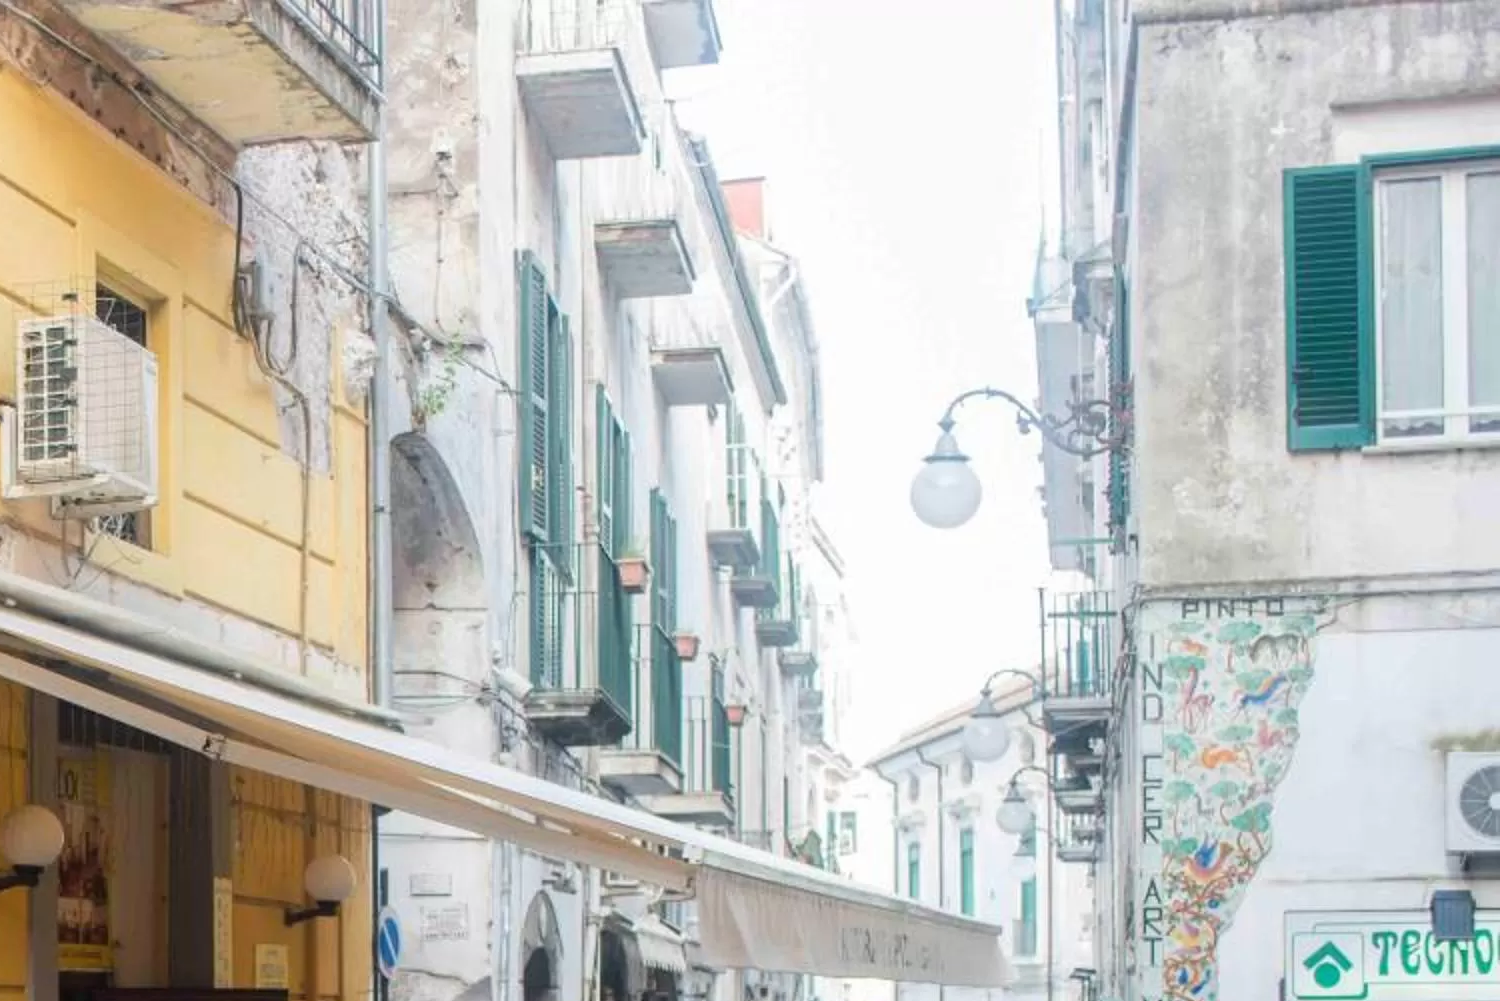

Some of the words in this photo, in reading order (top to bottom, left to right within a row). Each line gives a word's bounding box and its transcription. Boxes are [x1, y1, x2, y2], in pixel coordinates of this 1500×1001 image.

[1181, 599, 1285, 619] PINTO
[1142, 634, 1164, 722] IND
[1142, 879, 1164, 967] ART
[1372, 929, 1500, 976] TECNO
